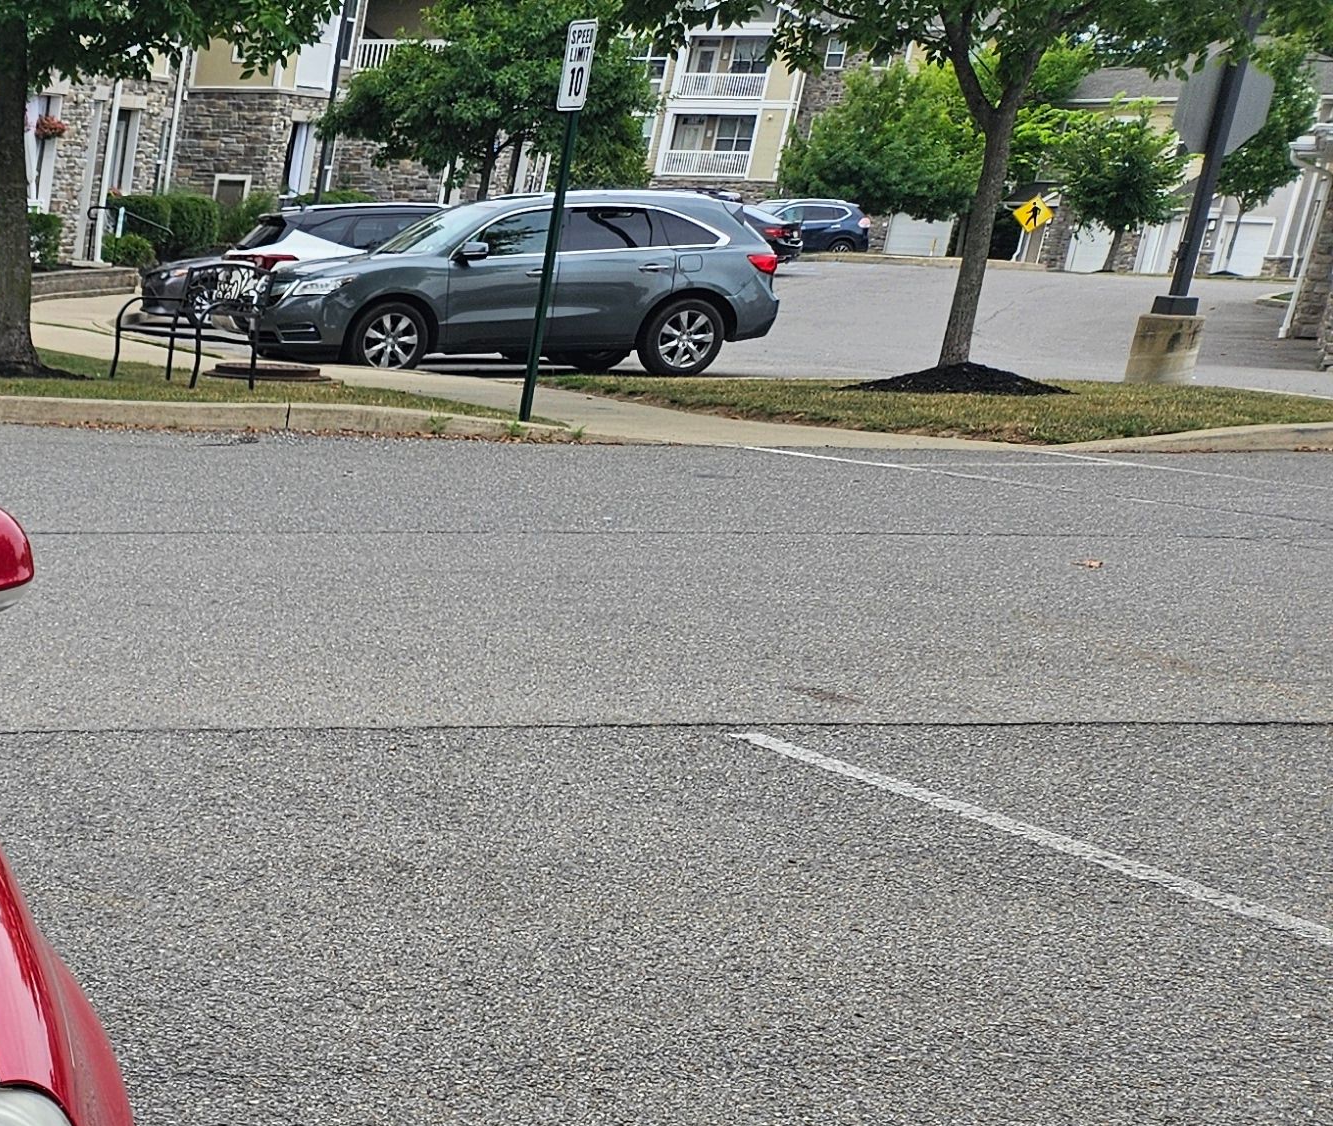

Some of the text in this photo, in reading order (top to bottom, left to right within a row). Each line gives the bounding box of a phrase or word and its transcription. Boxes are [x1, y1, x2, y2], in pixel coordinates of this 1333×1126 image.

[571, 28, 593, 44] SPEED
[569, 46, 591, 62] LIMIT
[568, 66, 584, 97] 10
